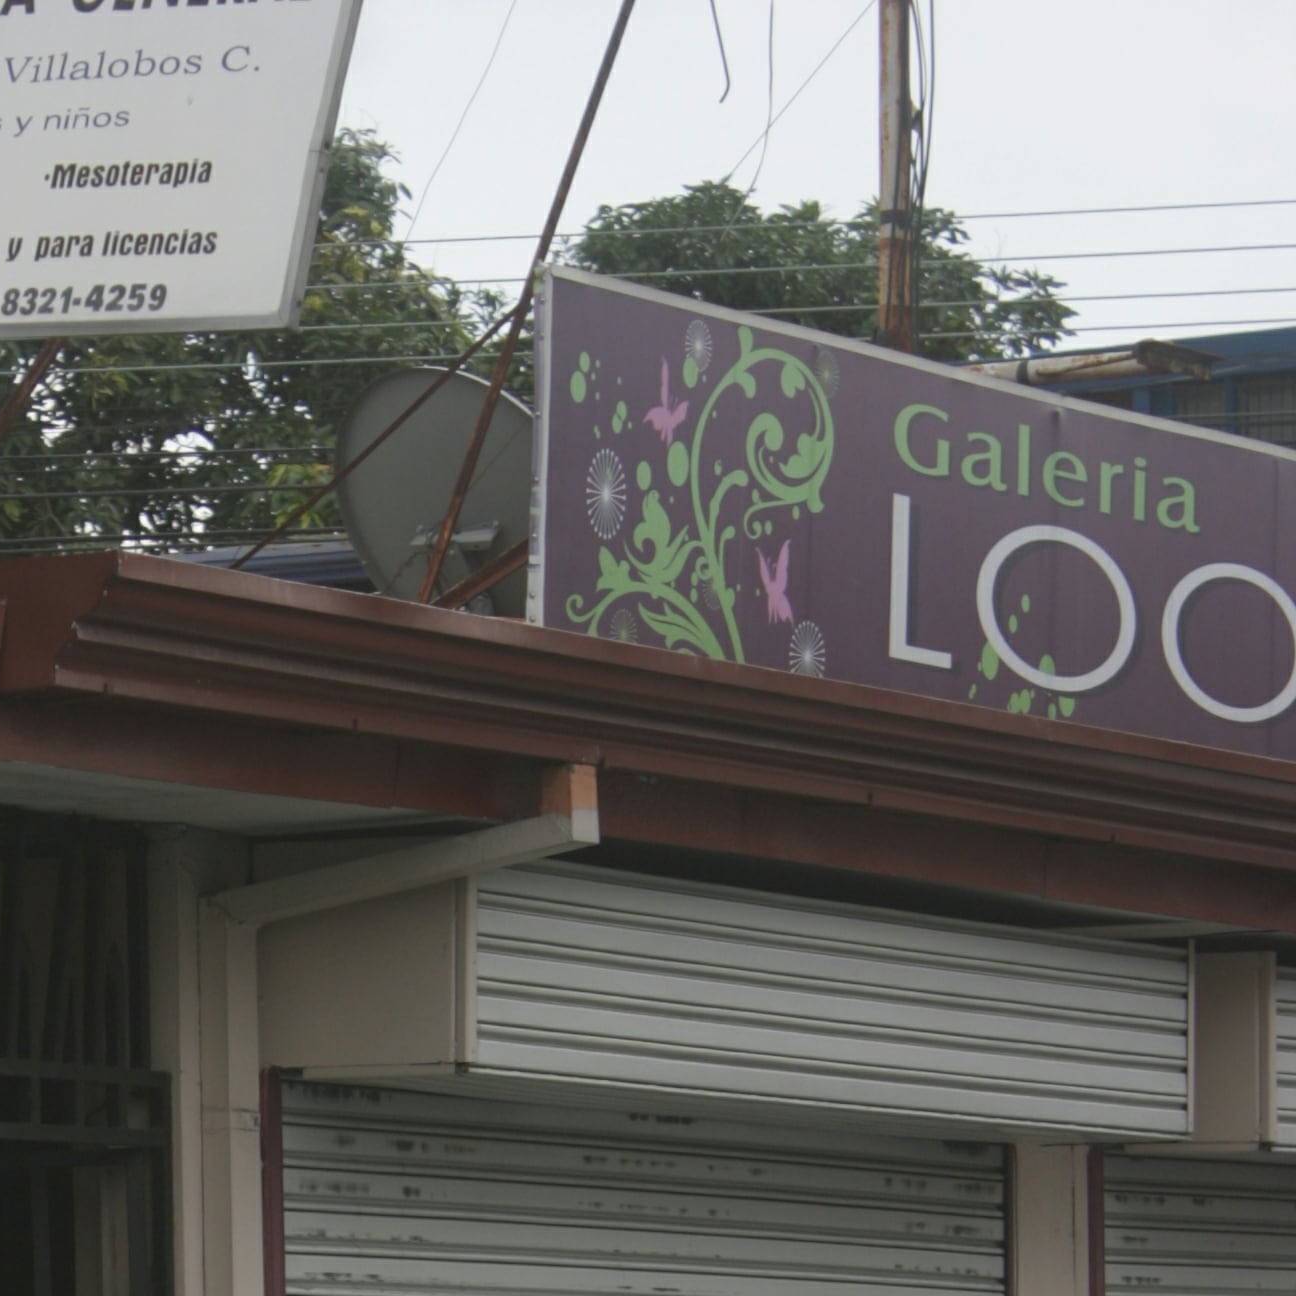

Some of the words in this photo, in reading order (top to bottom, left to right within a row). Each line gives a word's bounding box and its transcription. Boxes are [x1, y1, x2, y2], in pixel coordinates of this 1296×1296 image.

[4, 49, 204, 84] Villalobos
[221, 45, 260, 73] C.
[13, 115, 33, 138] y
[43, 107, 131, 131] niños
[50, 158, 213, 189] Mesoterapia
[6, 237, 23, 262] y
[34, 233, 95, 262] para
[101, 229, 218, 256] licencias
[0, 283, 168, 316] 8321-4259
[894, 404, 1200, 532] Galeria
